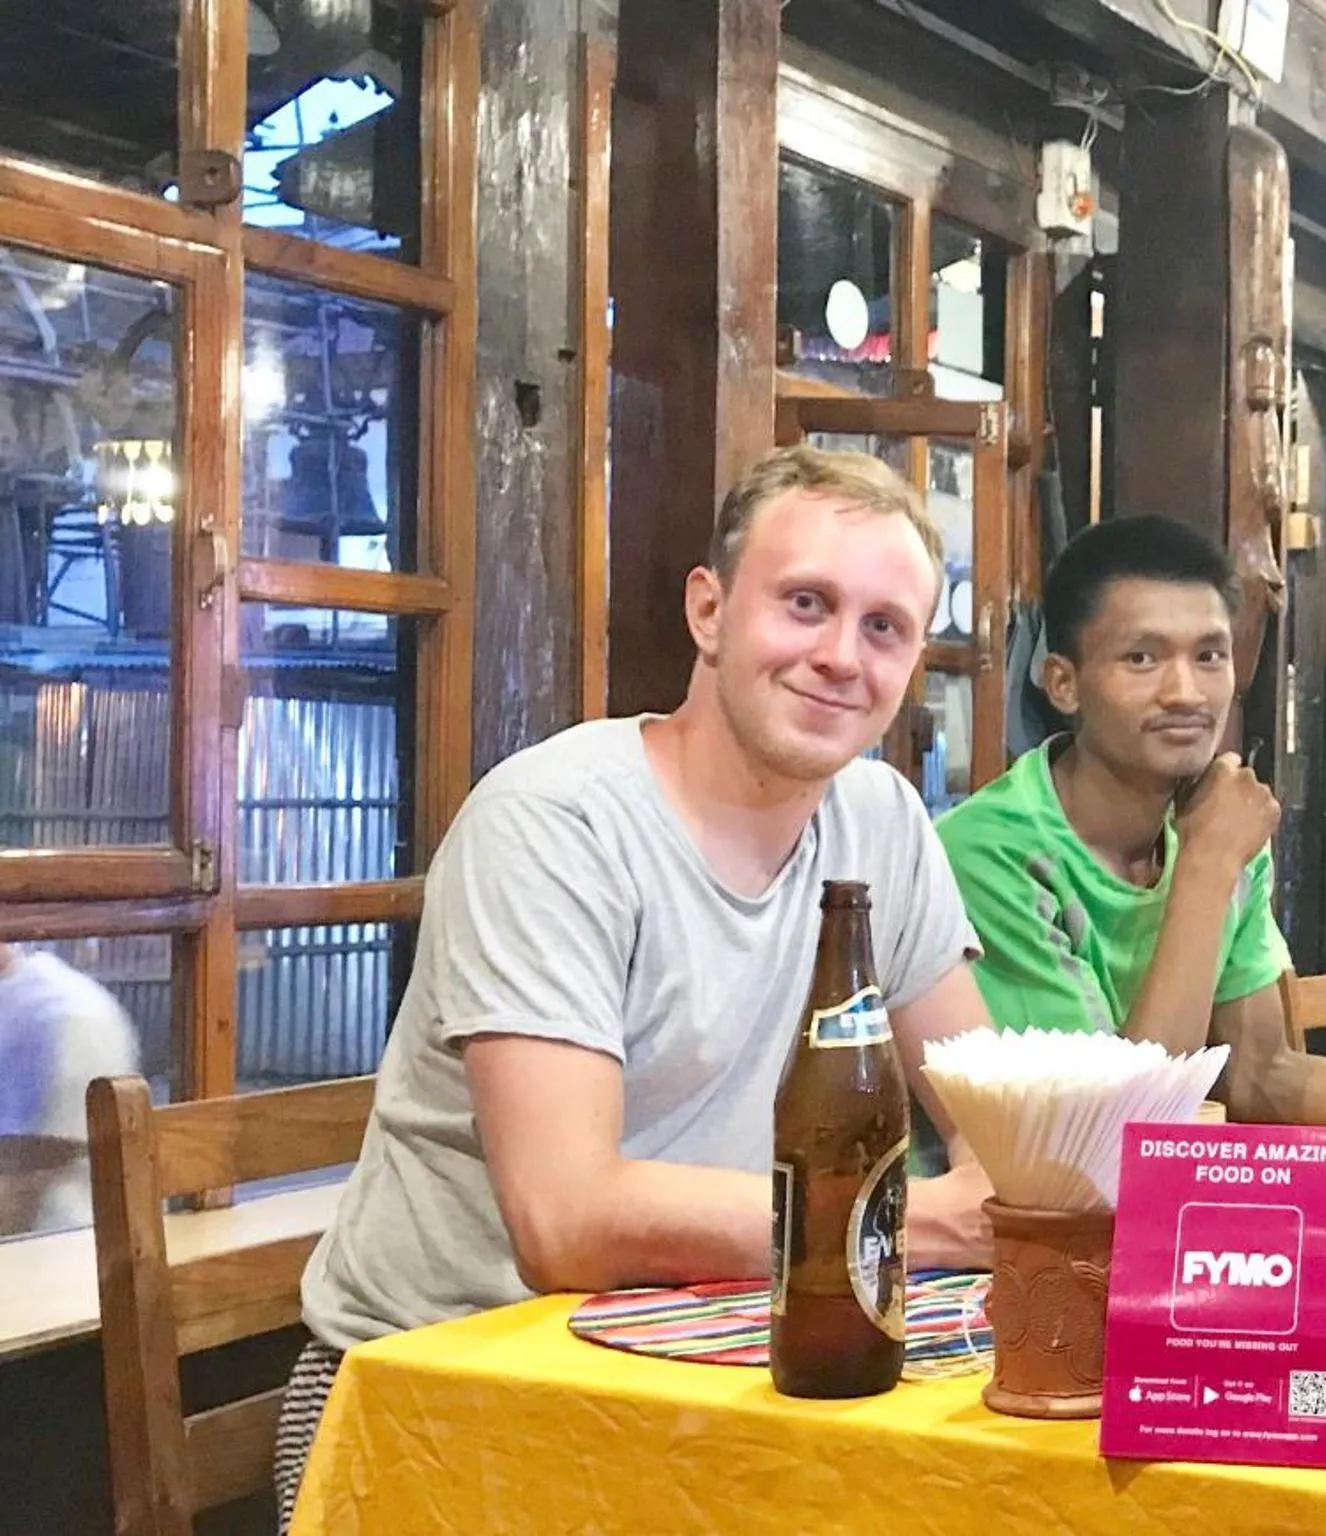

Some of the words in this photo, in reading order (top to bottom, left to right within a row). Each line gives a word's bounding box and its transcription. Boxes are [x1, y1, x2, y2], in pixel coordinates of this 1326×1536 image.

[1141, 1140, 1247, 1160] DISCOVER
[1196, 1166, 1253, 1183] FOOD
[1261, 1168, 1291, 1184] ON
[1182, 1251, 1293, 1287] FYMO
[1166, 1338, 1194, 1347] FOOD
[1195, 1339, 1232, 1349] YOU'RE
[1234, 1340, 1276, 1351] MISSING
[1278, 1343, 1299, 1352] OUT
[1144, 1390, 1165, 1402] App
[1166, 1391, 1191, 1402] Store
[1224, 1391, 1256, 1404] Google
[1256, 1392, 1272, 1405] Play
[1139, 1424, 1153, 1433] For
